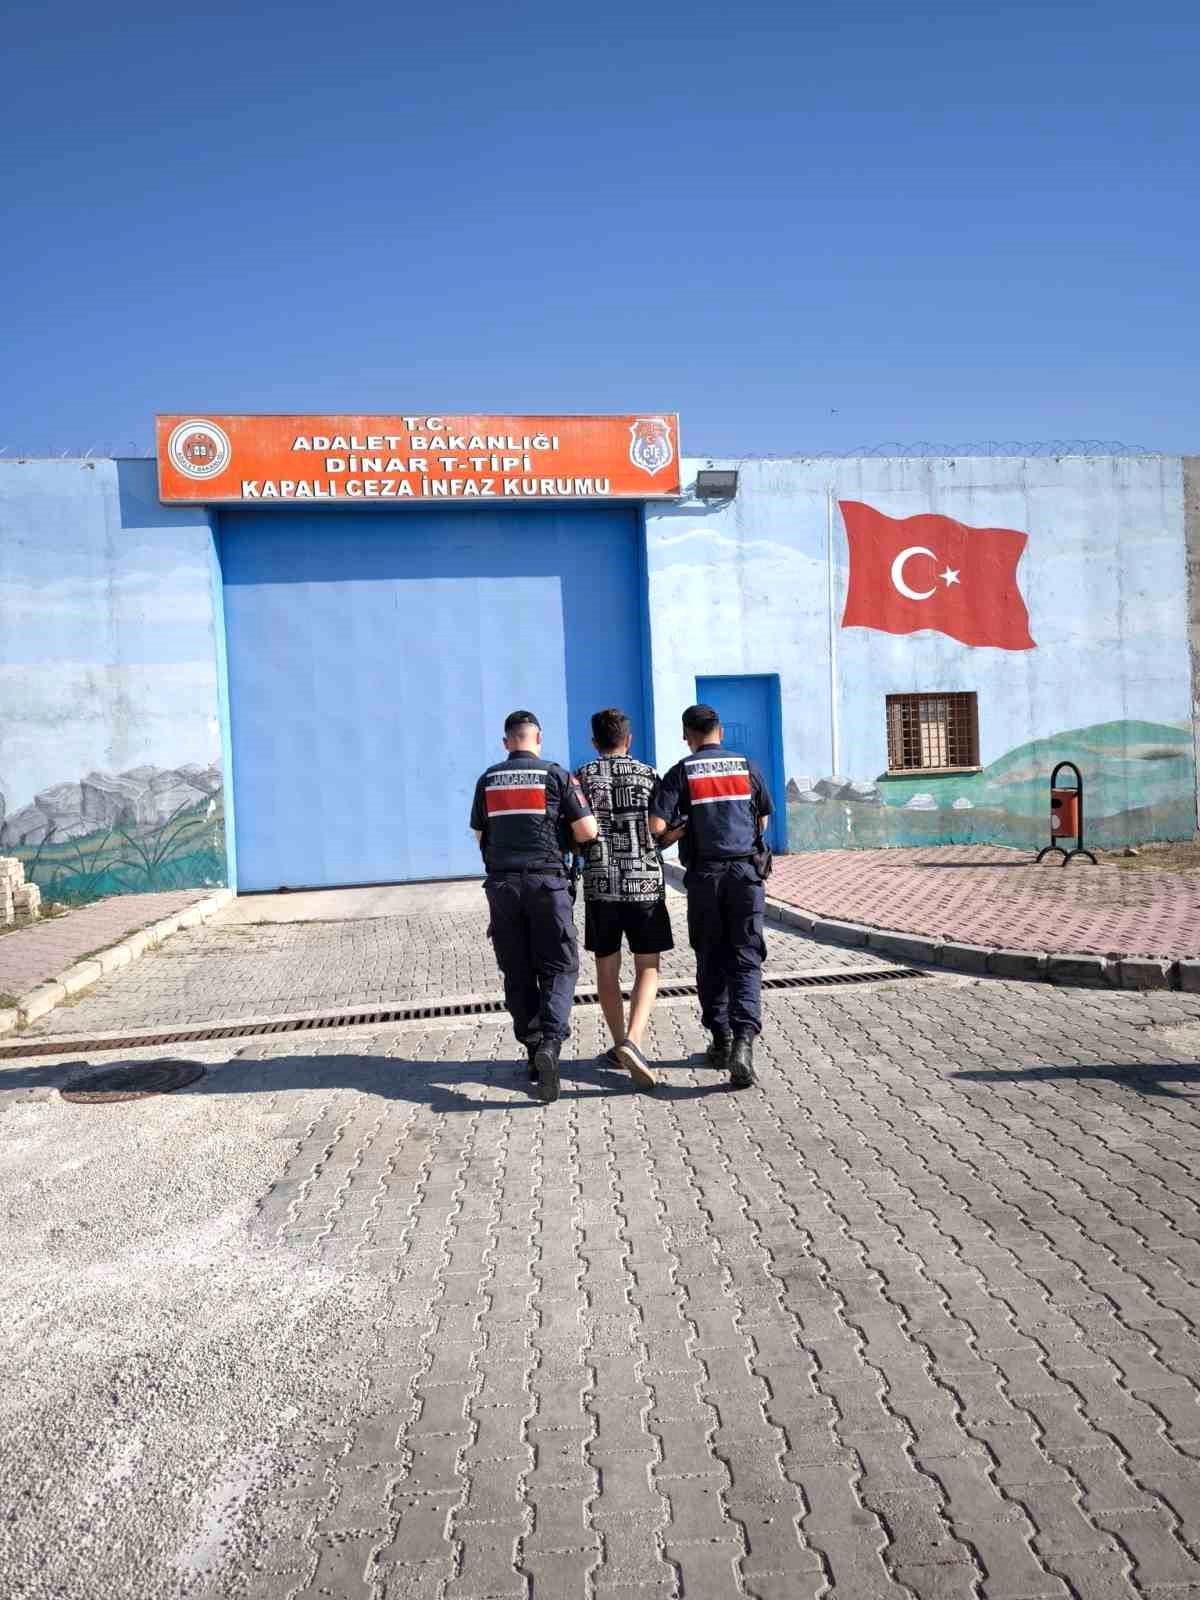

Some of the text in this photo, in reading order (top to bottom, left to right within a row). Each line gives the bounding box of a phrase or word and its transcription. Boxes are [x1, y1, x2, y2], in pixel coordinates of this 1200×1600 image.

[403, 417, 452, 431] T.C.
[293, 433, 560, 451] ADALET BAKANLIĞI
[325, 455, 532, 472] DİNAR T-TİPİ
[241, 476, 610, 497] KAPALI CEZA İNFAZ KURUMU
